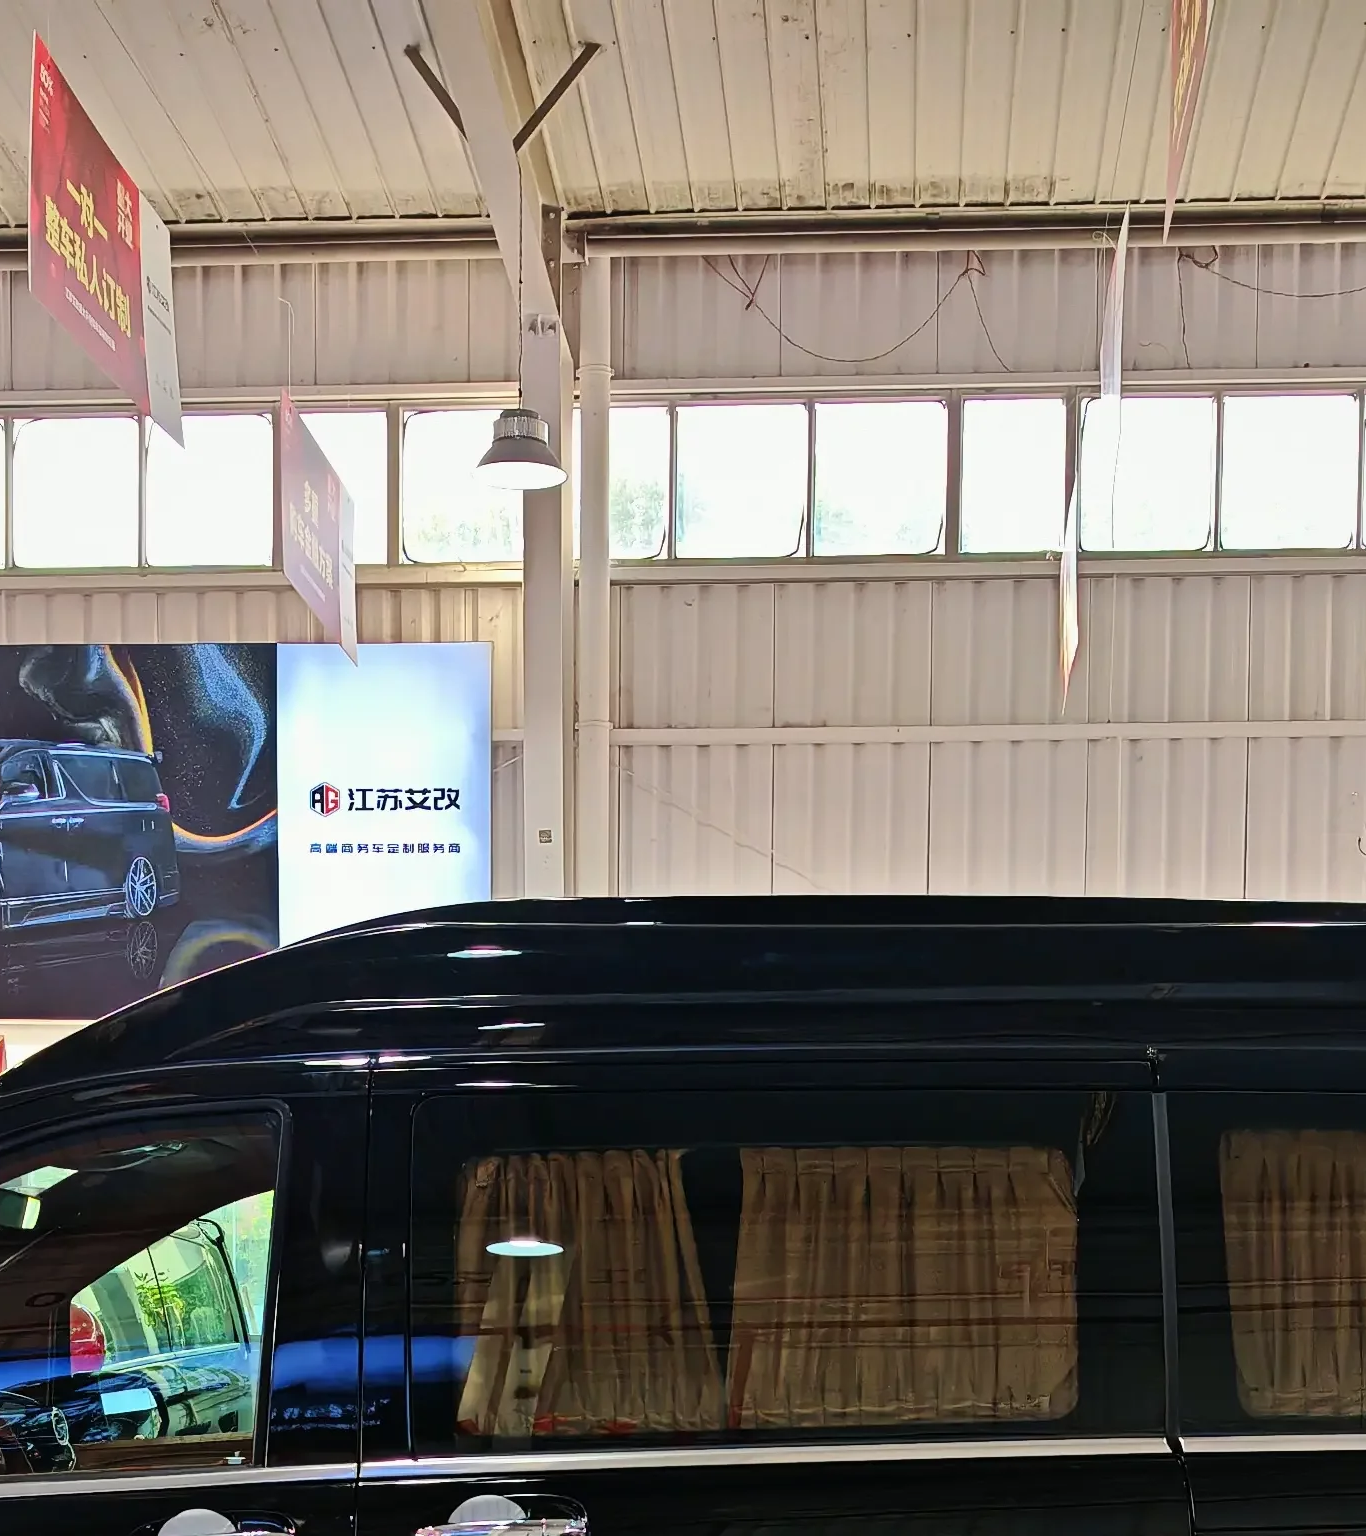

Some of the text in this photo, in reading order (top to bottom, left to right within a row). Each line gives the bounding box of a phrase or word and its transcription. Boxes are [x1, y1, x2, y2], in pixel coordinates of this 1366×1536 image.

[66, 178, 108, 242] 一对一
[45, 194, 132, 339] 整车私人订制
[347, 787, 461, 811] 江苏艾改
[309, 843, 461, 854] 高端商务车定制服务商
